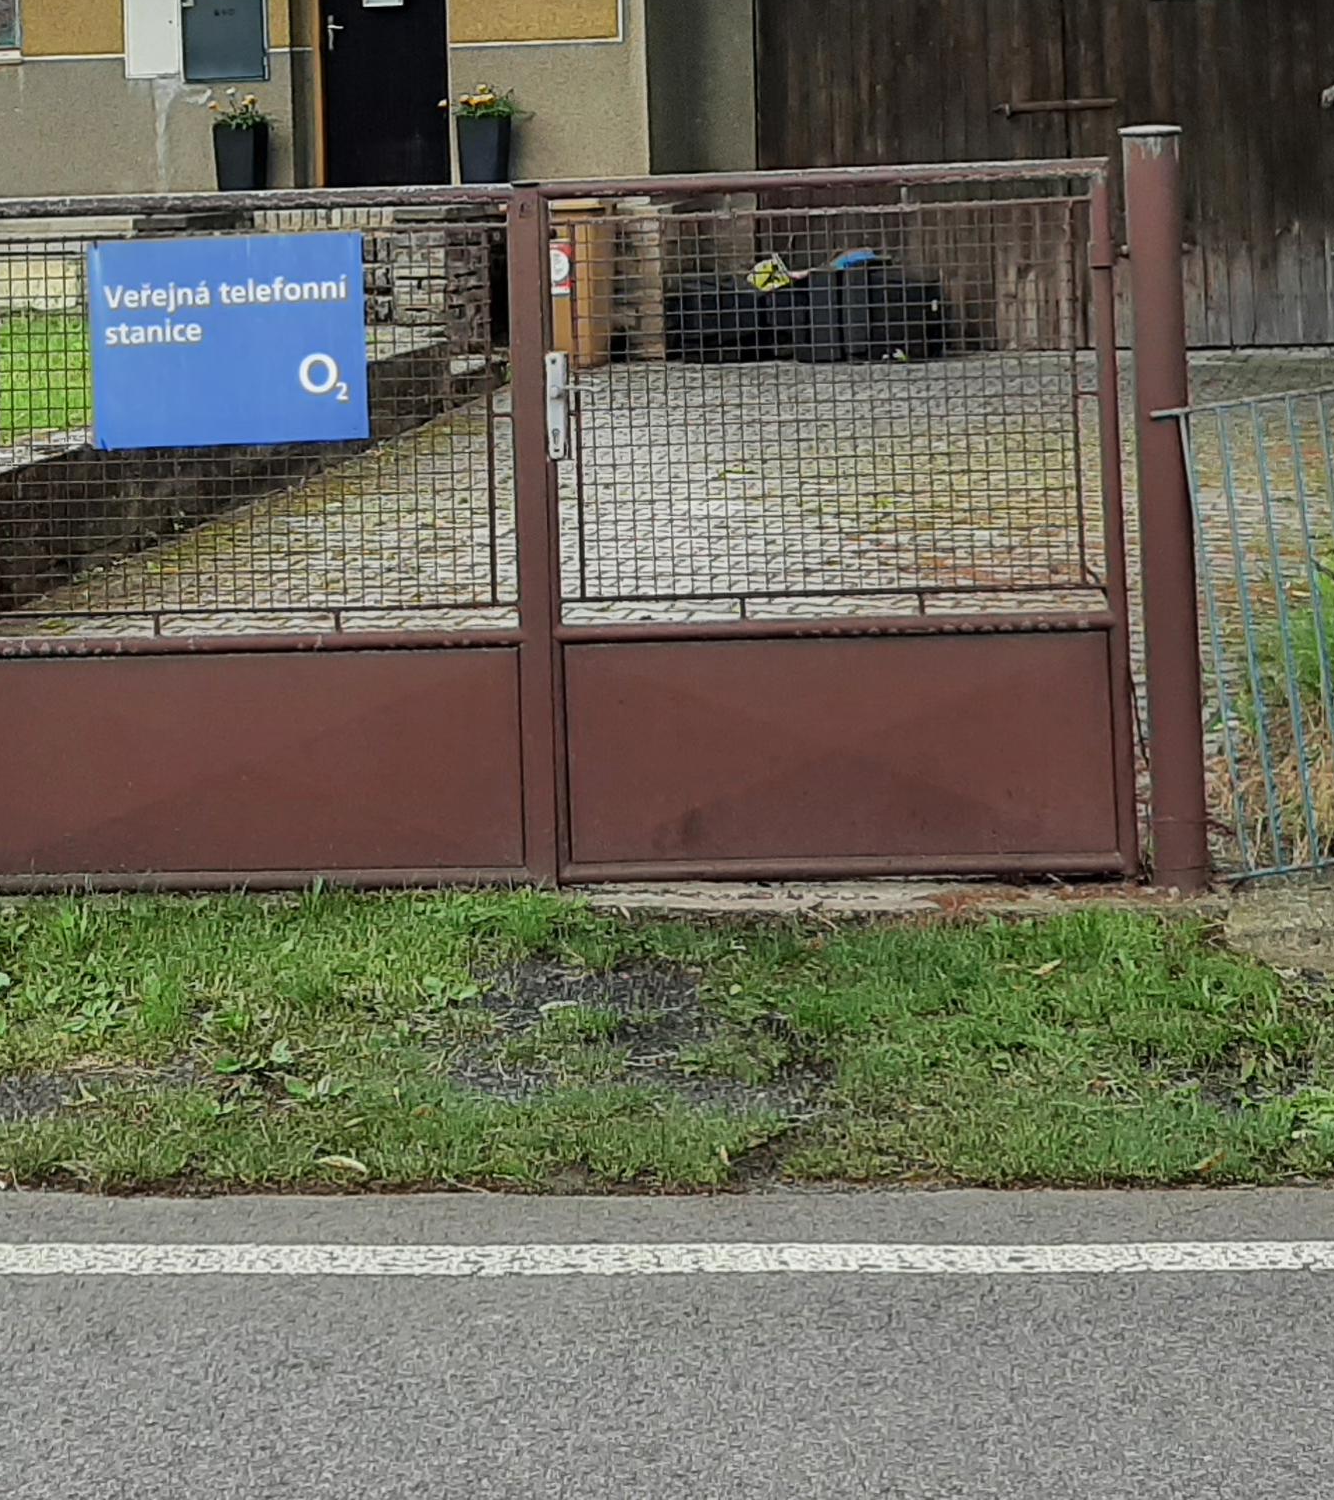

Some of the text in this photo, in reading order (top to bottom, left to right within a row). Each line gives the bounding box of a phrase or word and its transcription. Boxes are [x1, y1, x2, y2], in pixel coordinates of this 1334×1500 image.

[104, 274, 347, 312] Veřejná telefonní
[105, 319, 203, 345] stanice
